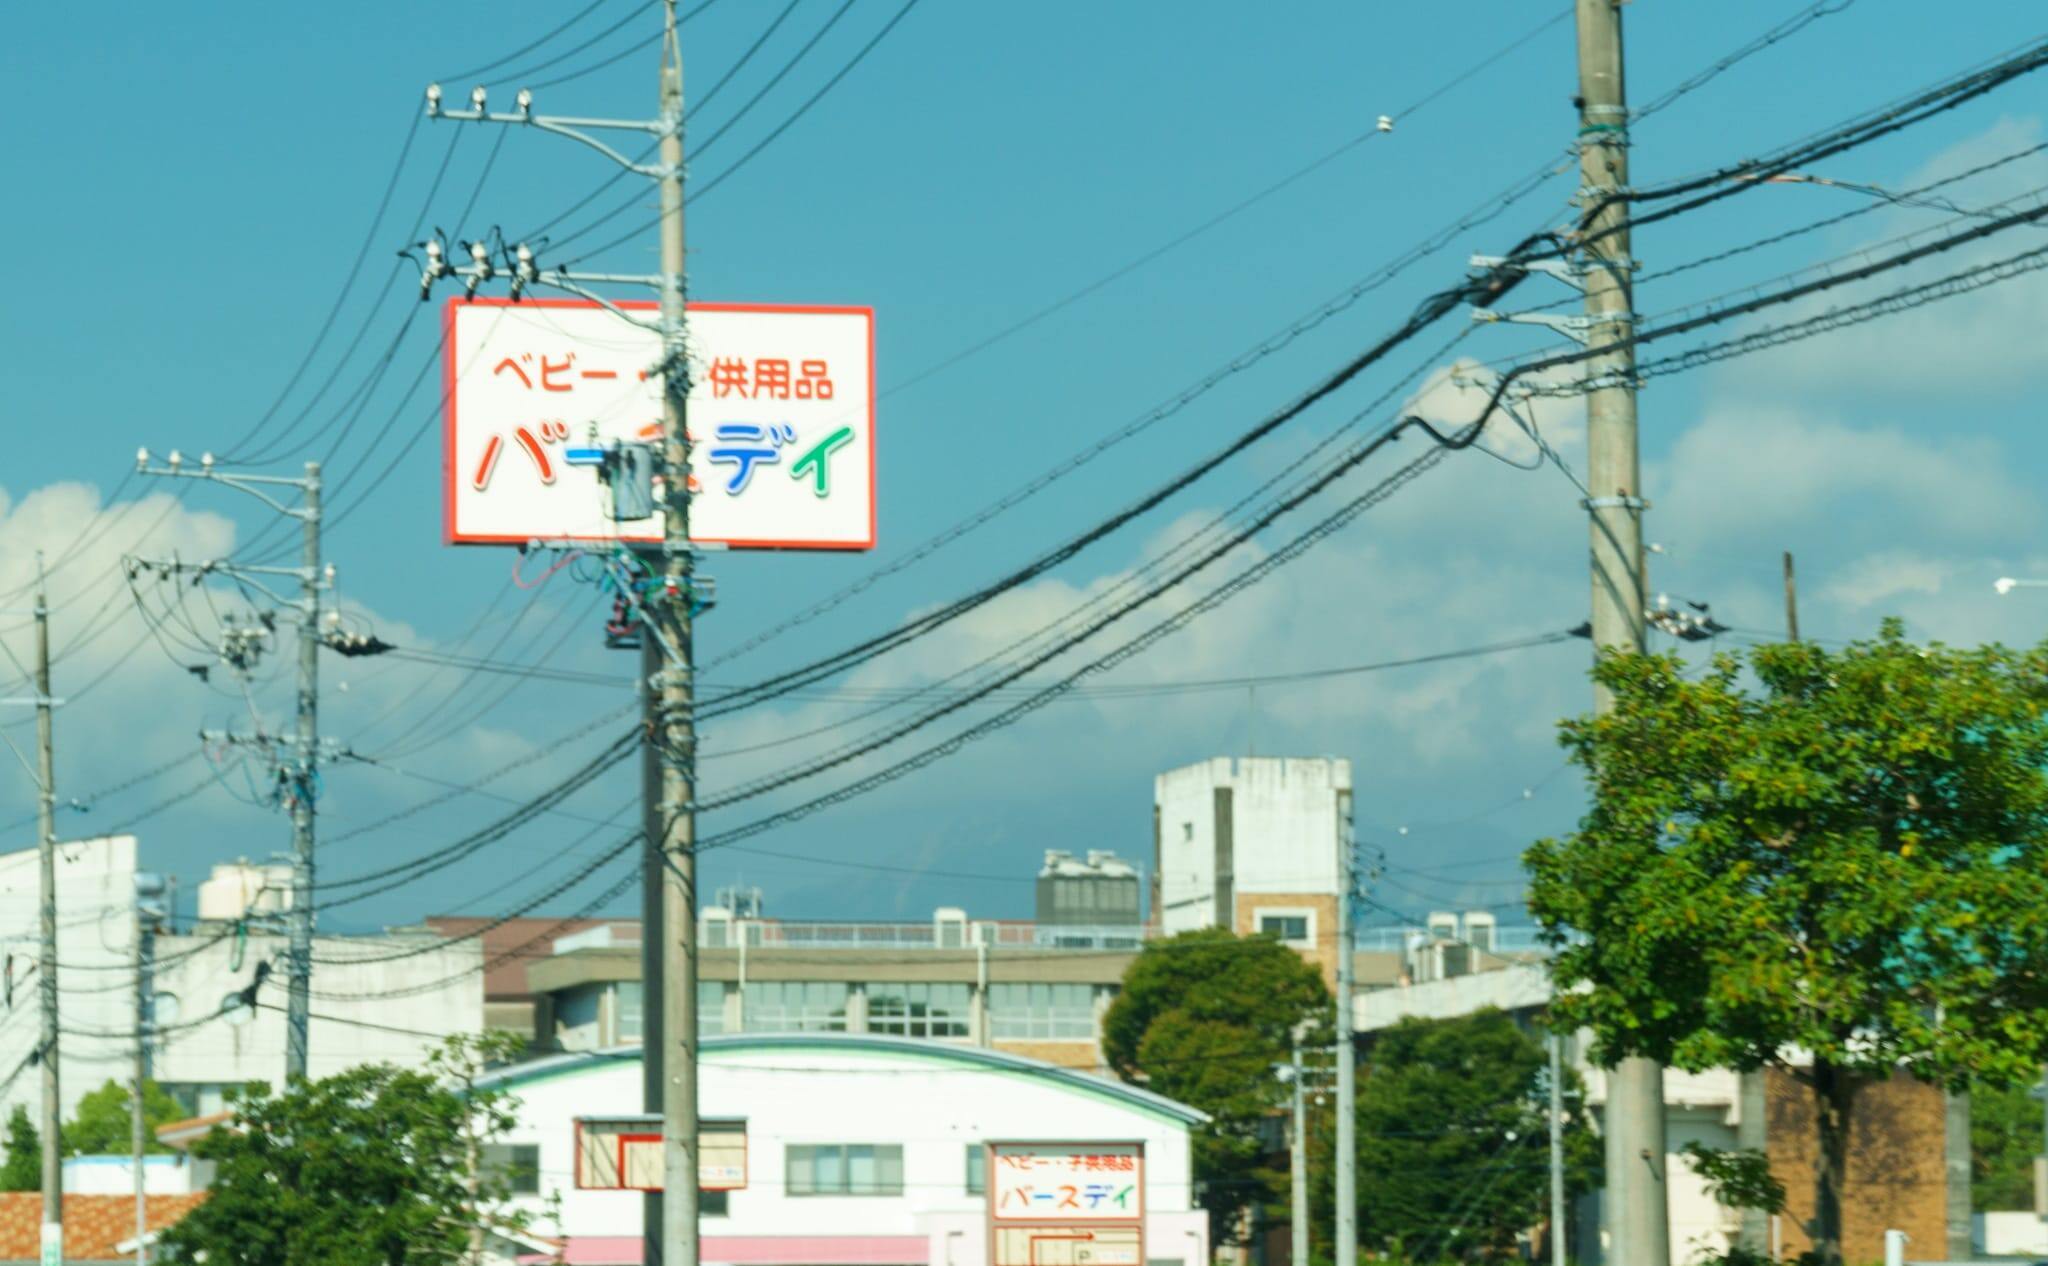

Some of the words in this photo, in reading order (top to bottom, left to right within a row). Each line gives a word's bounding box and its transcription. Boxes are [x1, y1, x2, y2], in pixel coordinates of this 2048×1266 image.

[494, 352, 833, 399] ベビー・供用品
